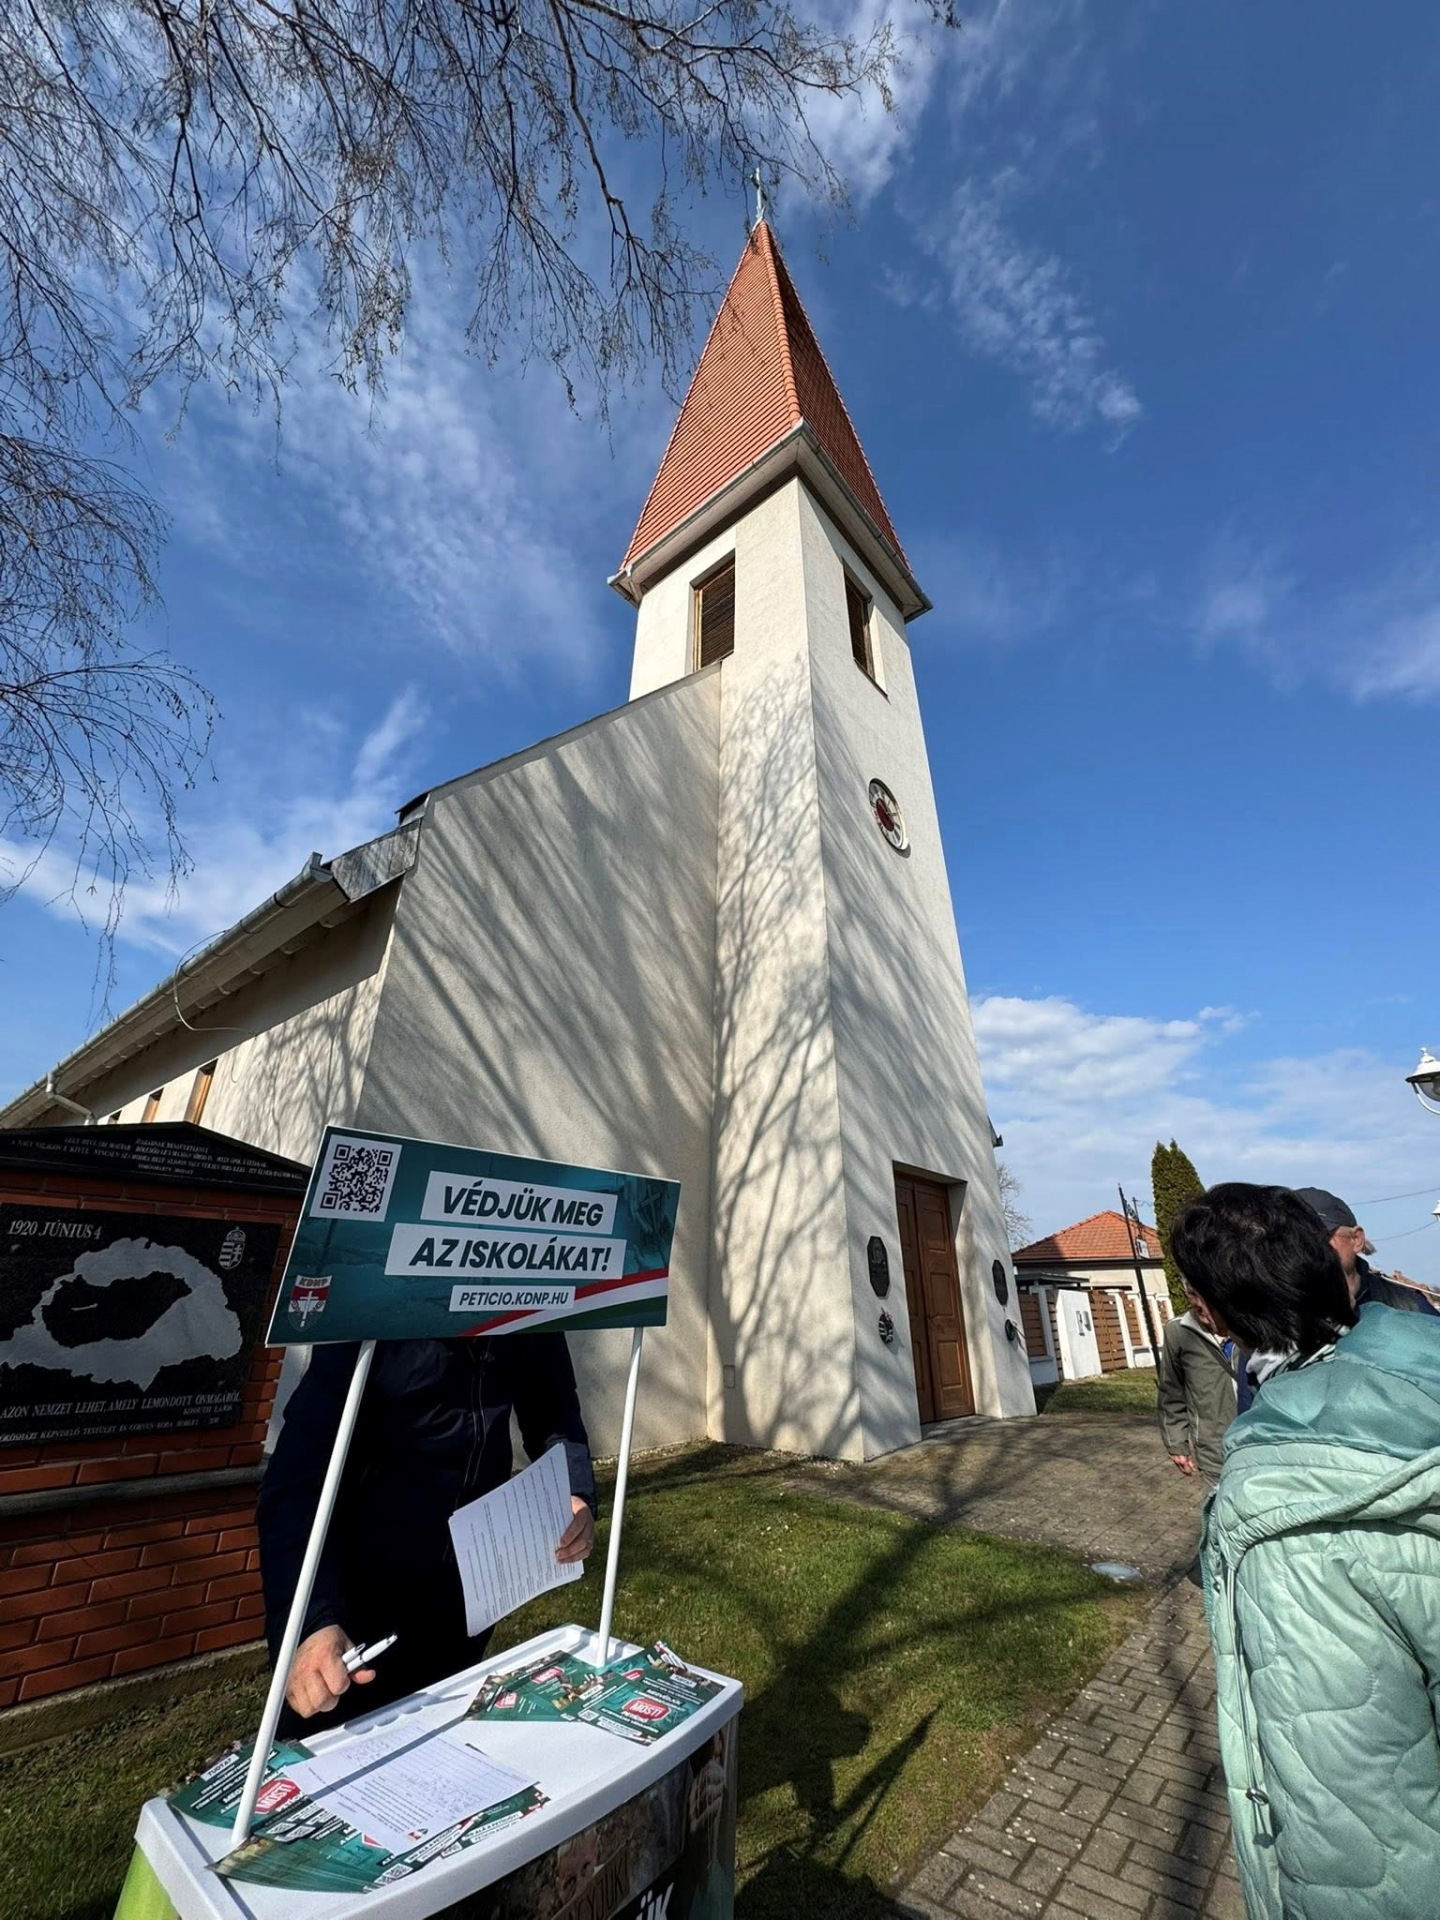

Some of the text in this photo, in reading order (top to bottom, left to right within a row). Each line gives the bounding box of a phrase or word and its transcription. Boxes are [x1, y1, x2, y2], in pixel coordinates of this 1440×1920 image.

[443, 1180, 604, 1227] VÉDJÜK MEG
[7, 1219, 103, 1240] 1920 JÚNIUS 4
[409, 1236, 611, 1272] AZ ISKOLÁKAT!
[458, 1290, 570, 1308] PETICIO.KDNP.HU
